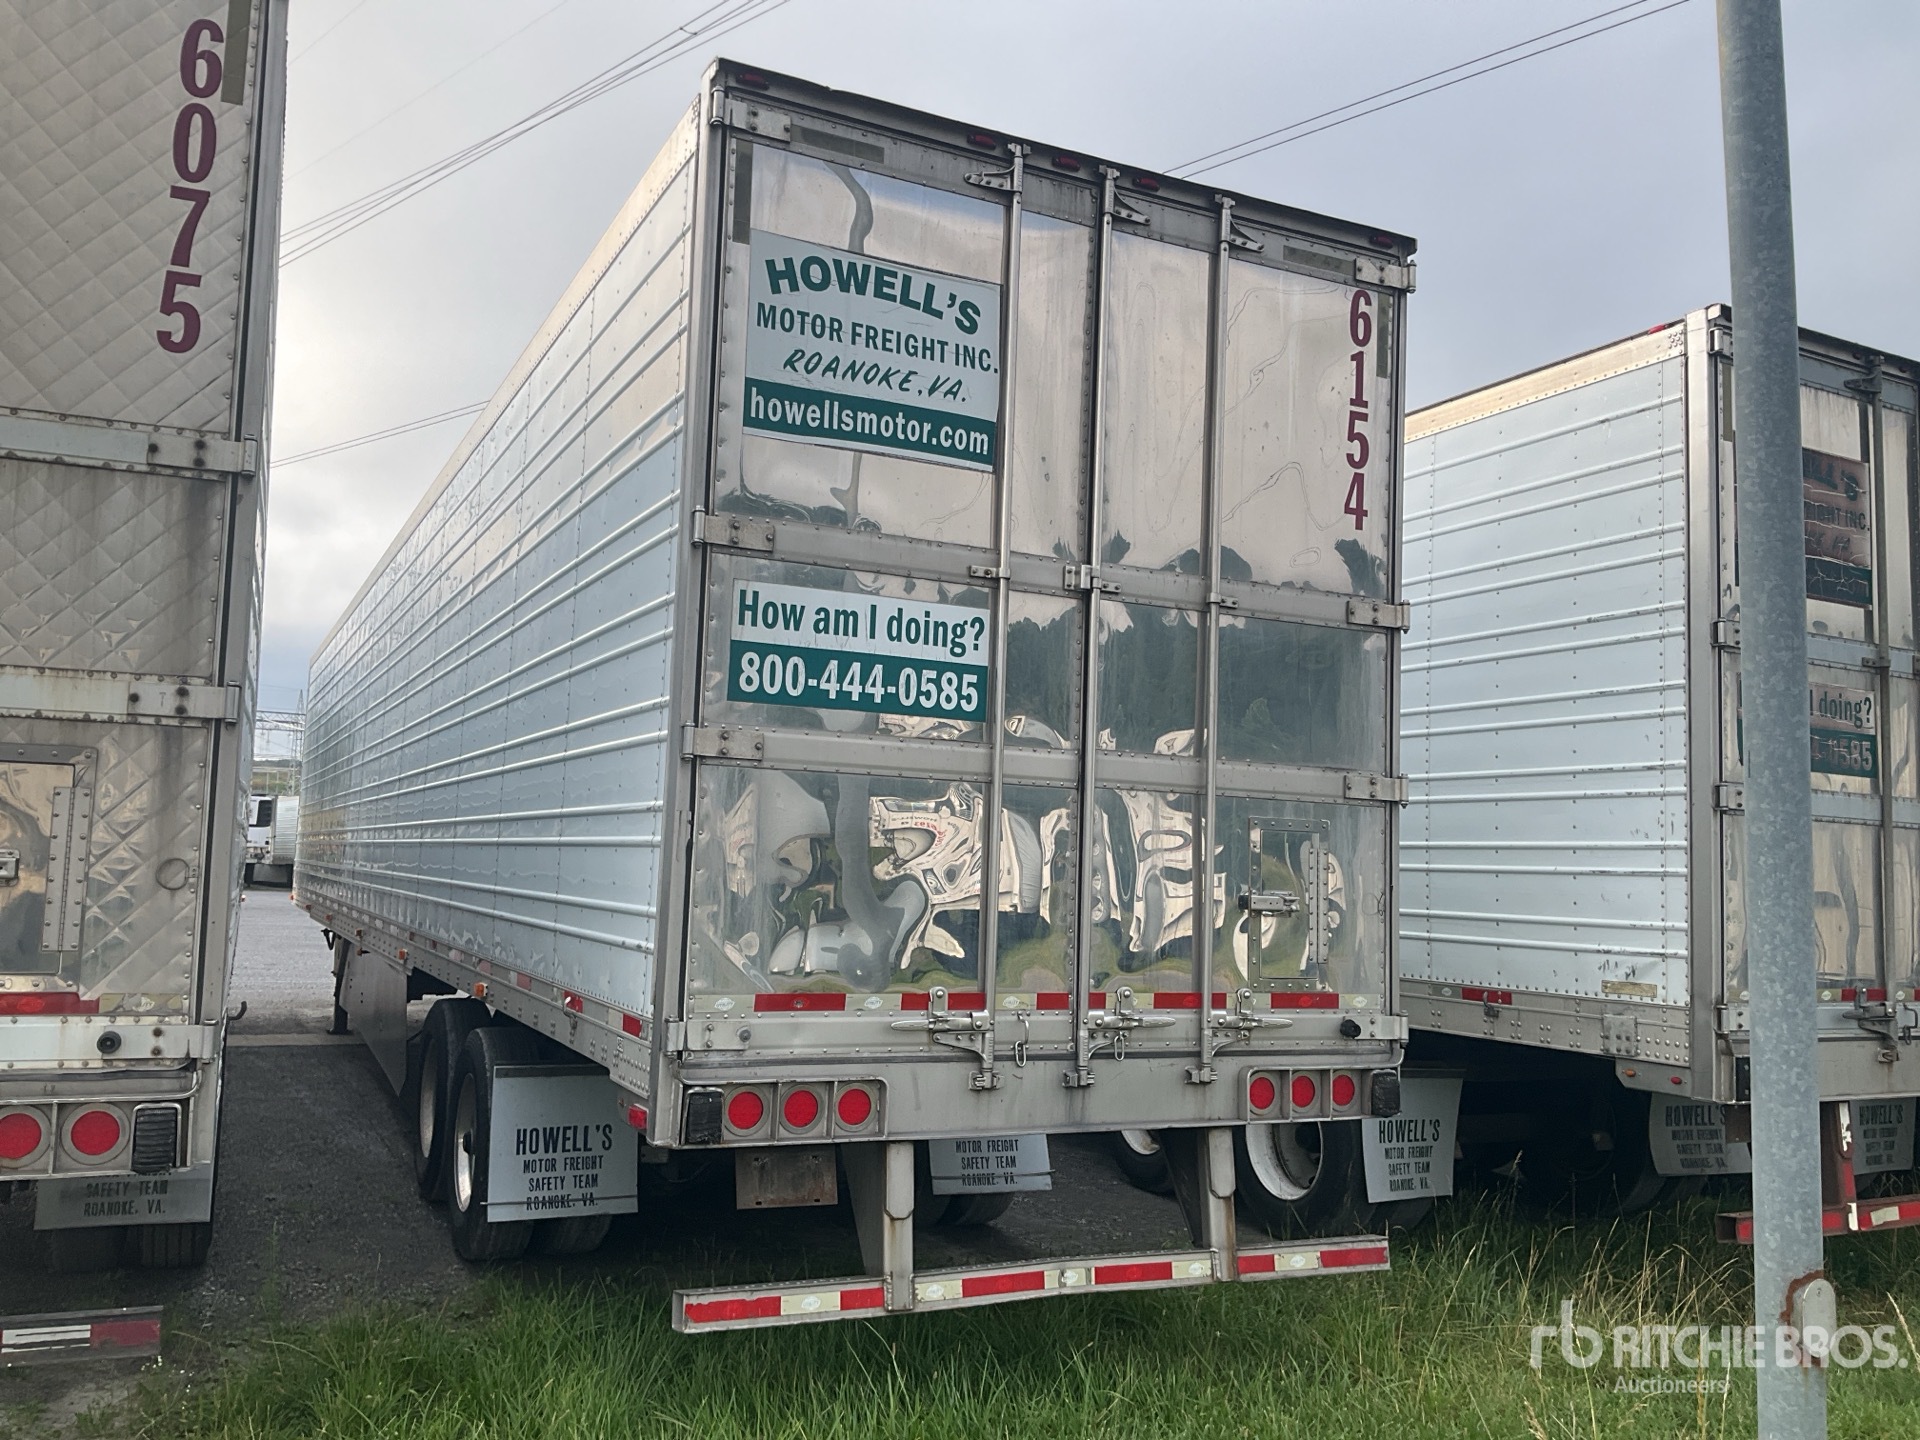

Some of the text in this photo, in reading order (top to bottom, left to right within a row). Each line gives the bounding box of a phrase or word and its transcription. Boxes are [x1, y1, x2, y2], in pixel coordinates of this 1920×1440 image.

[156, 19, 224, 353] 6075
[765, 256, 981, 334] HOWELL'S
[757, 302, 999, 374] MOTOR FREIGHT INC.
[750, 387, 989, 455] howellsmotor.com
[1344, 289, 1372, 531] 6154
[738, 589, 985, 657] How am I doing?
[738, 651, 978, 712] 800-444-0585
[1819, 691, 1872, 729] doing?
[516, 1124, 613, 1155] HOWELL'S
[956, 1139, 1018, 1153] MOTOR FREIGHT
[1379, 1119, 1440, 1143] HOWELL'S
[523, 1155, 604, 1174] MOTOR FREIGHT
[962, 1156, 1017, 1170] SAFETY TEAM
[87, 1180, 168, 1198] SAFETY TEAM
[528, 1173, 598, 1192] SAFETY TEAM
